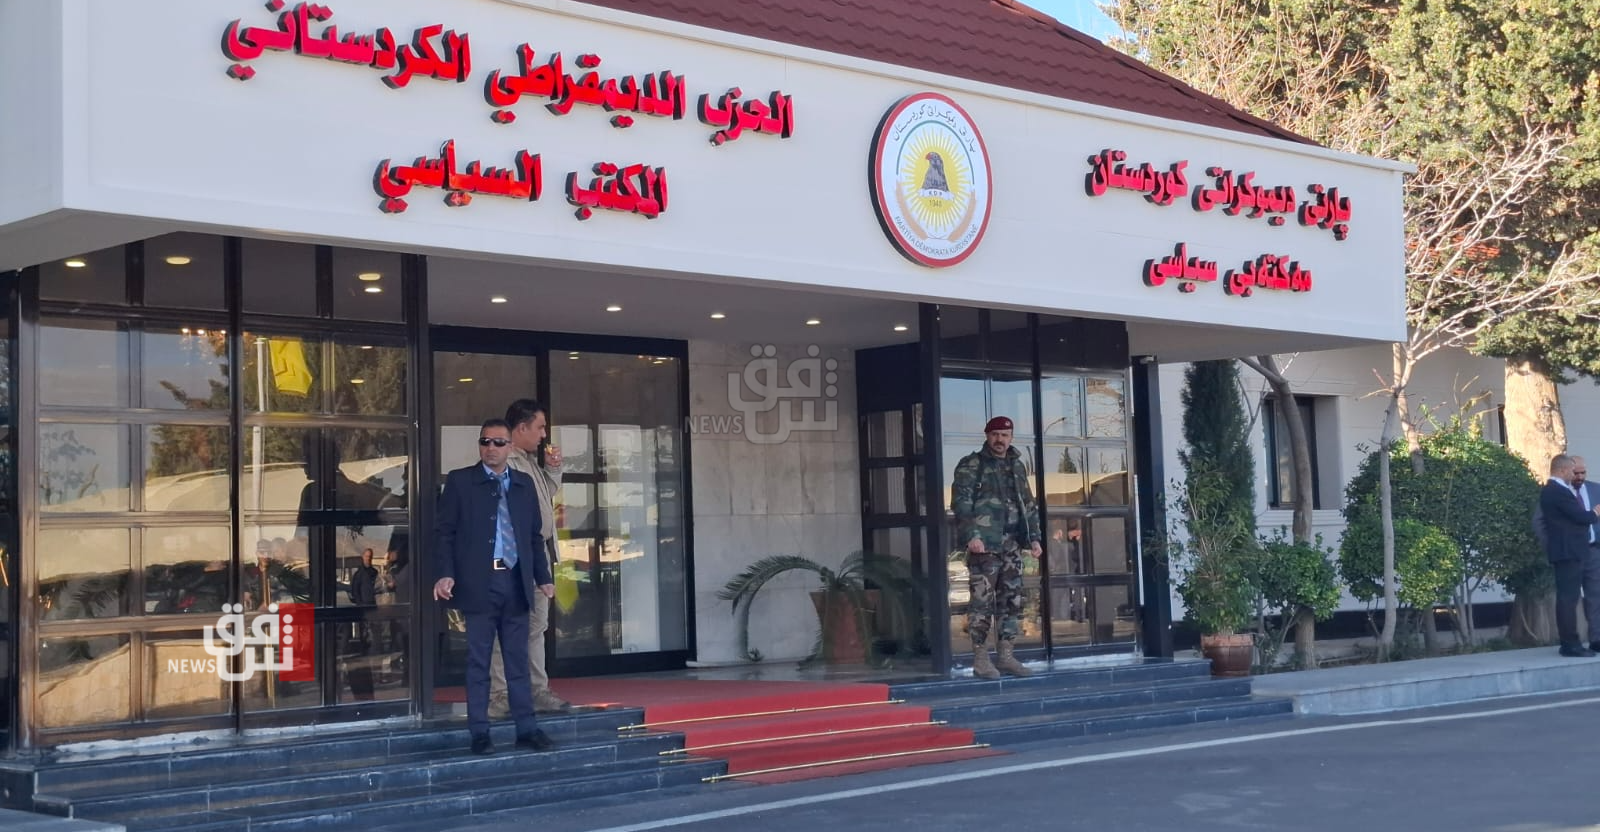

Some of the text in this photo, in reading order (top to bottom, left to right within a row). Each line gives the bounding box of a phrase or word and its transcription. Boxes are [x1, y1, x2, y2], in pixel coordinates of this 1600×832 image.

[221, 0, 793, 147] الحزب الديمقراطي الكردستاني
[373, 139, 669, 220] المكتب السياسي
